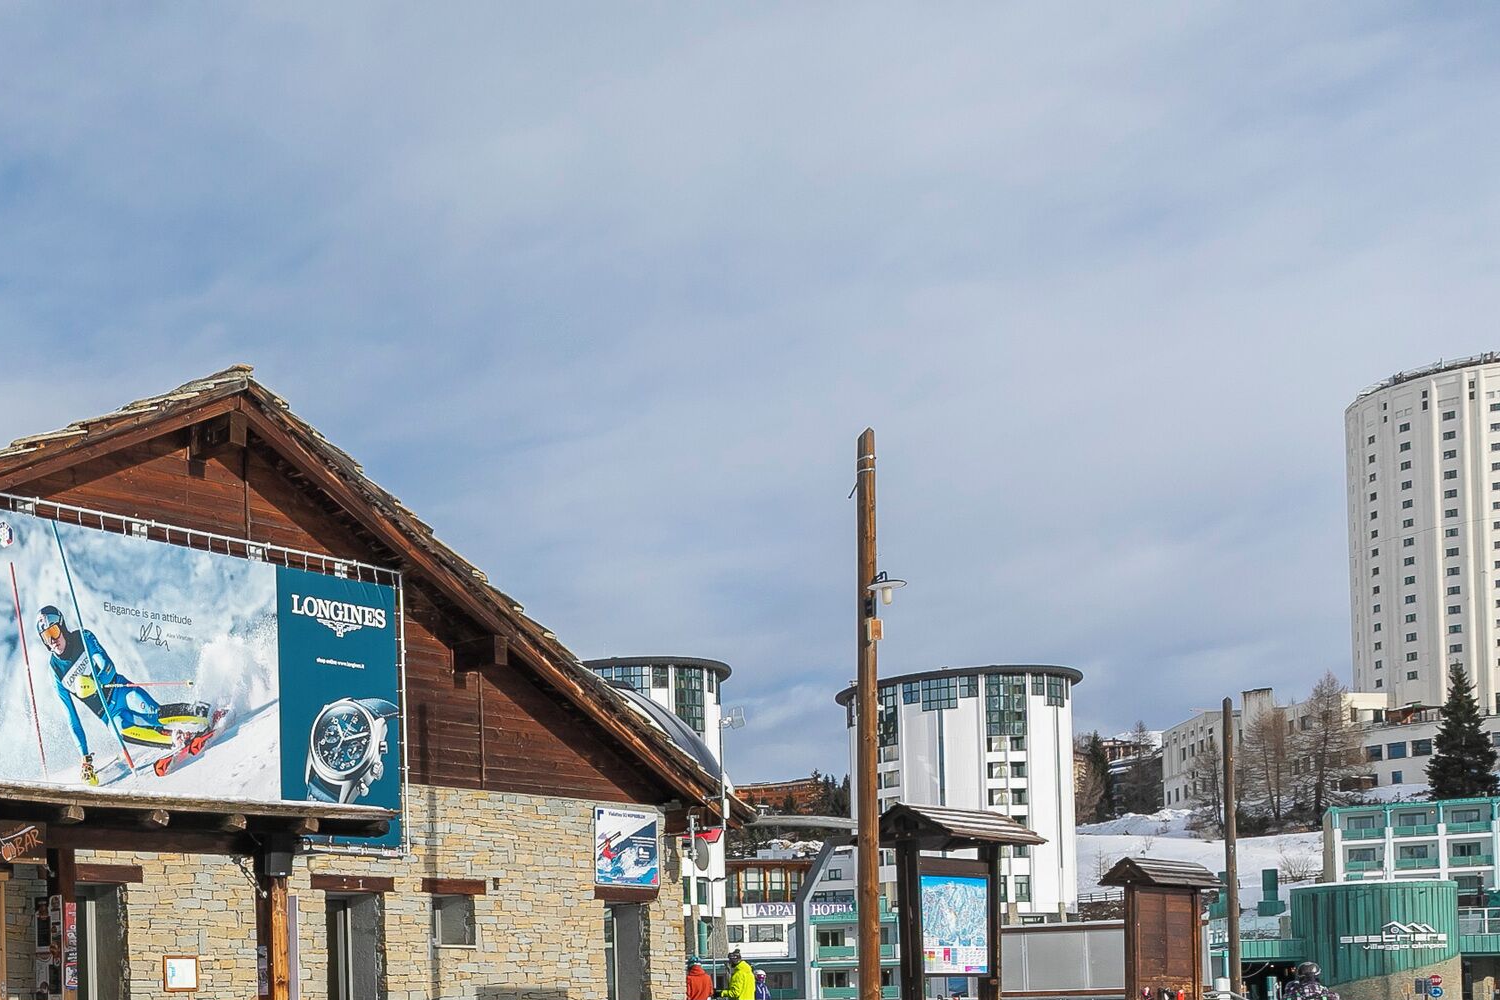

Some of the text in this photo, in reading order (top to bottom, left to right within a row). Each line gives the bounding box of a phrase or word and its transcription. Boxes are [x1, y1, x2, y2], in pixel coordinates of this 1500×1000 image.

[103, 601, 192, 626] Elegance is an attitude
[291, 594, 386, 629] LONGINES
[14, 829, 43, 857] BAR
[812, 903, 853, 917] HOTELS
